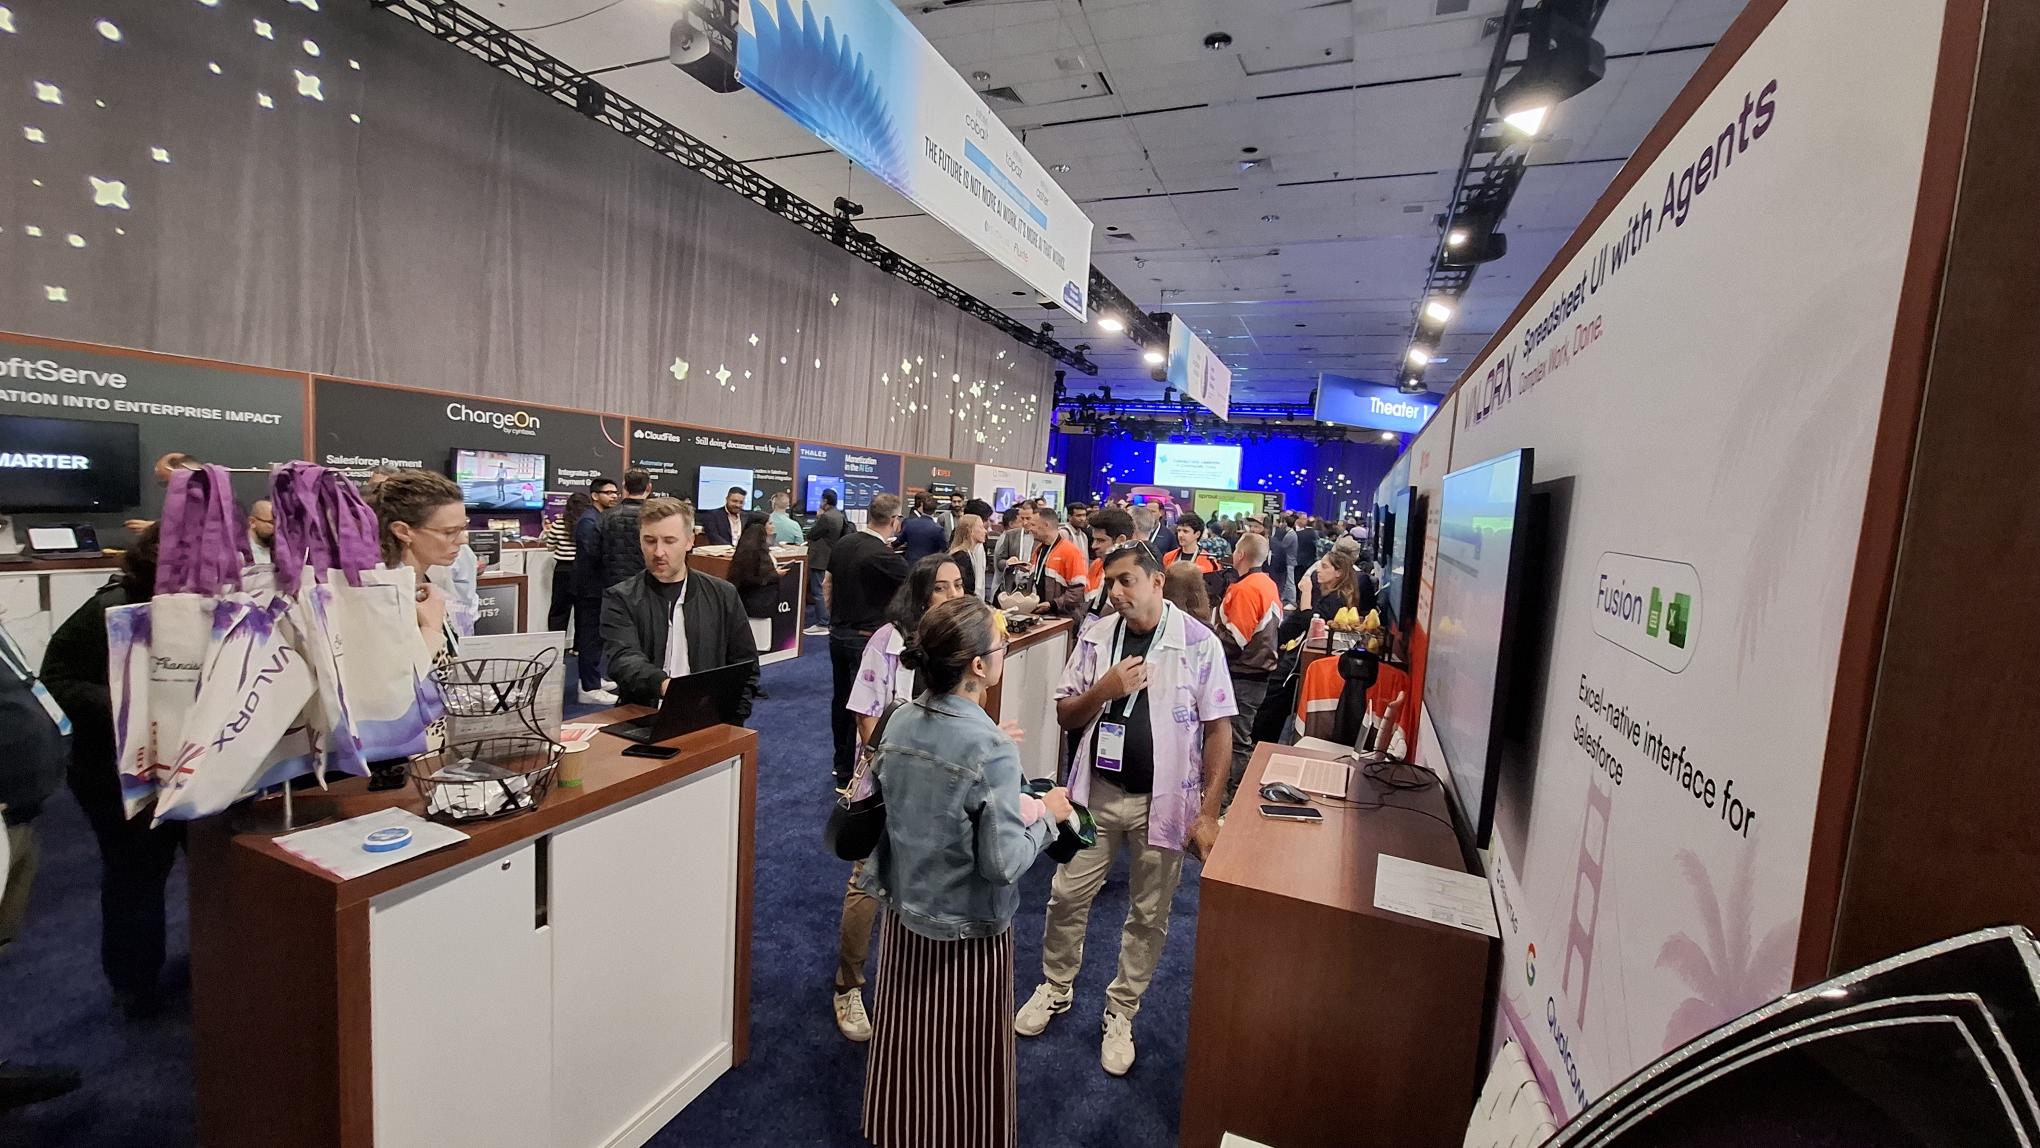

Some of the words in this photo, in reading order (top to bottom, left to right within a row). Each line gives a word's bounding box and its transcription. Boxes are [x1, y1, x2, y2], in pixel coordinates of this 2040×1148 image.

[925, 135, 938, 164] THE
[939, 147, 962, 184] FUTURE
[963, 168, 969, 189] IS
[970, 174, 981, 198] NOT
[982, 184, 997, 213] MORE
[1523, 270, 1588, 363] Spreadsheet
[1590, 244, 1609, 297] UI
[1611, 201, 1653, 276] with
[1657, 78, 1778, 233] Agents
[1519, 361, 1547, 396] Complex
[1573, 314, 1604, 357] Done.
[63, 394, 111, 411] INTO
[114, 399, 222, 421] ENTERPRISE
[225, 409, 282, 425] IMPACT
[446, 403, 541, 429] ChargeOn
[1370, 397, 1419, 419] Theater
[644, 430, 681, 442] CloudFiles
[695, 435, 709, 446] Still
[709, 438, 726, 450] doing
[727, 440, 754, 451] document
[755, 444, 769, 452] work
[769, 445, 776, 455] by
[0, 452, 89, 470] MARTER
[326, 454, 380, 466] Salesforce
[381, 458, 422, 468] Payment
[800, 449, 827, 458] THALES
[845, 454, 877, 465] Monetization
[558, 468, 588, 477] Integrates
[850, 464, 858, 472] the
[558, 478, 585, 486] Payment
[1597, 574, 1643, 625] Fusion
[212, 644, 296, 752] VALORX
[1573, 714, 1624, 786] Salesforce
[1578, 674, 1641, 747] Excel-native
[1643, 721, 1716, 809] interface
[1721, 779, 1756, 839] for
